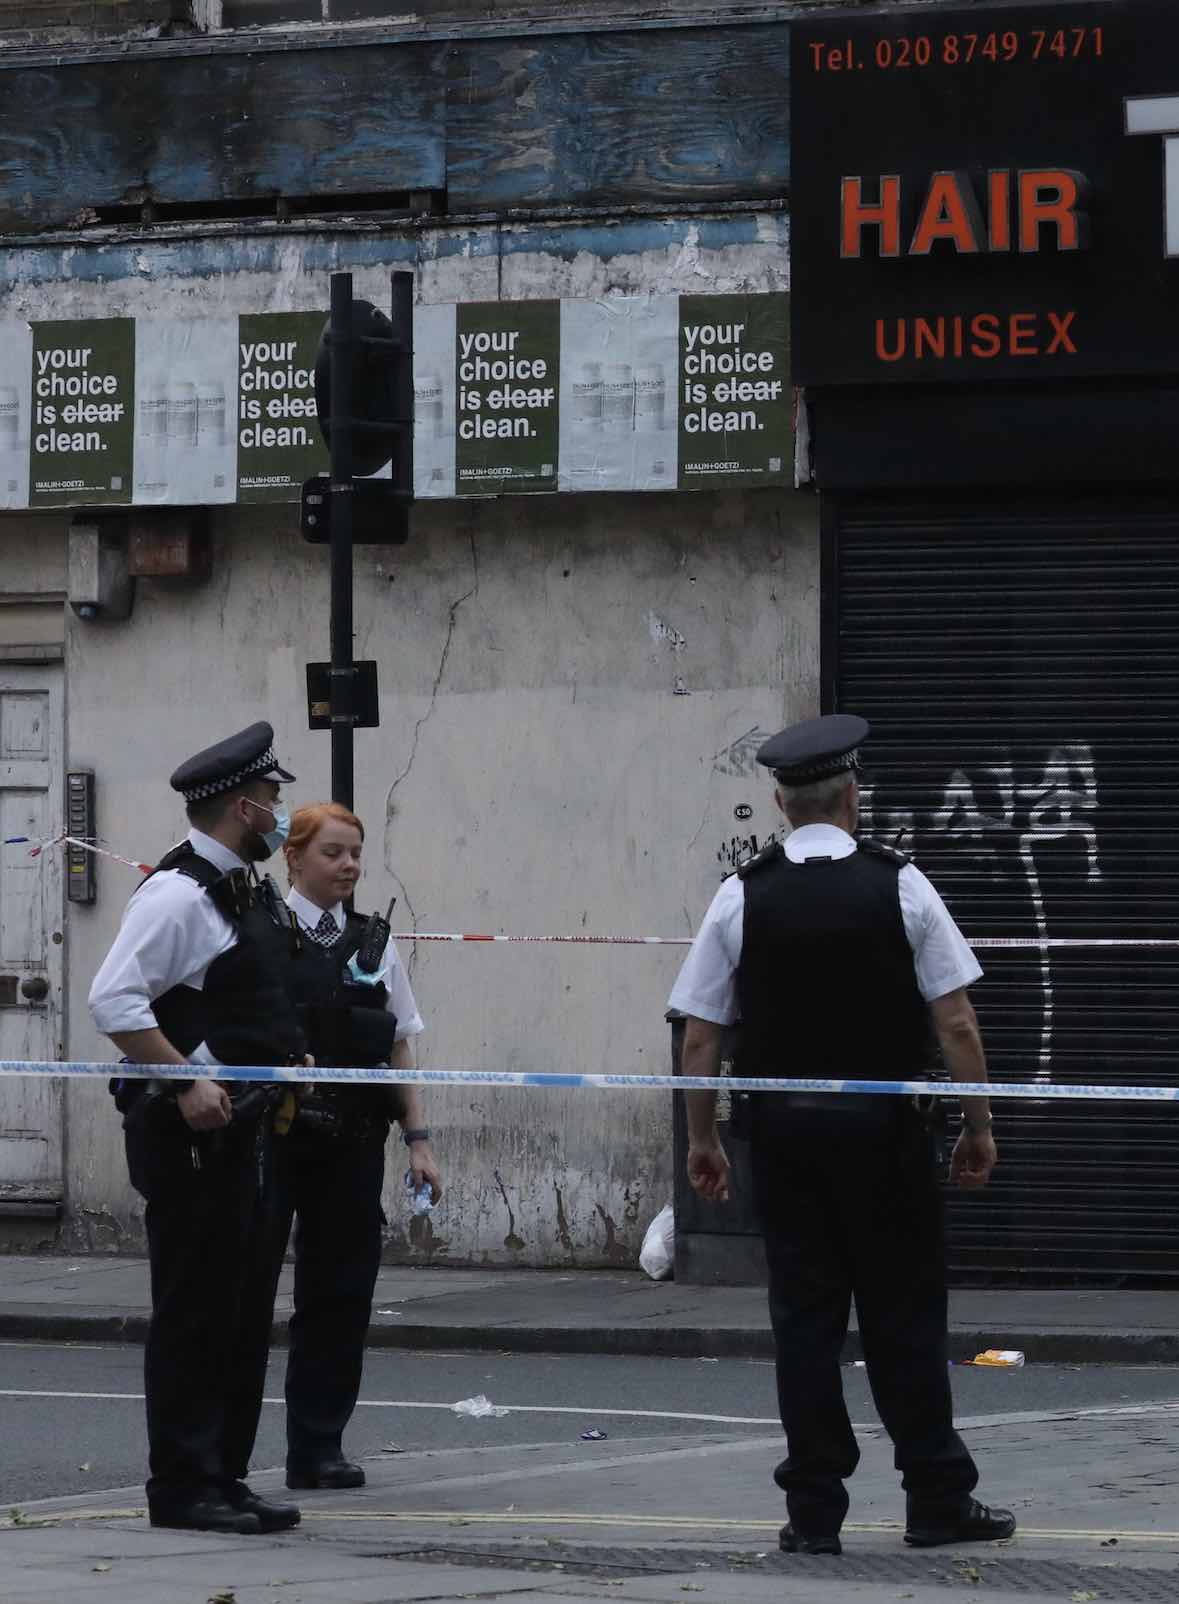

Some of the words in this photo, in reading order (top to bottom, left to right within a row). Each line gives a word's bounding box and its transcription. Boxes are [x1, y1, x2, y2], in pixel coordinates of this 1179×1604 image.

[812, 40, 866, 71] Tel.
[875, 37, 933, 68] 020
[942, 31, 1020, 65] 8749
[1032, 27, 1104, 60] 7471
[840, 168, 1080, 257] HAIR
[459, 332, 519, 359] your
[684, 324, 745, 352] your
[874, 311, 1078, 362] UNISEX
[36, 348, 92, 375] your
[240, 342, 297, 369] your
[459, 355, 547, 382] choice
[684, 347, 774, 375] choice
[36, 371, 118, 397] choice
[460, 385, 481, 410] is
[486, 383, 555, 409] clear
[684, 378, 708, 404] is
[711, 376, 783, 403] clear
[36, 400, 57, 425] is
[61, 399, 125, 424] clear
[240, 394, 261, 419] is
[265, 392, 319, 418] clea
[459, 413, 538, 440] clean.
[683, 406, 765, 433] clean.
[35, 428, 108, 453] clean.
[240, 422, 314, 448] clean.
